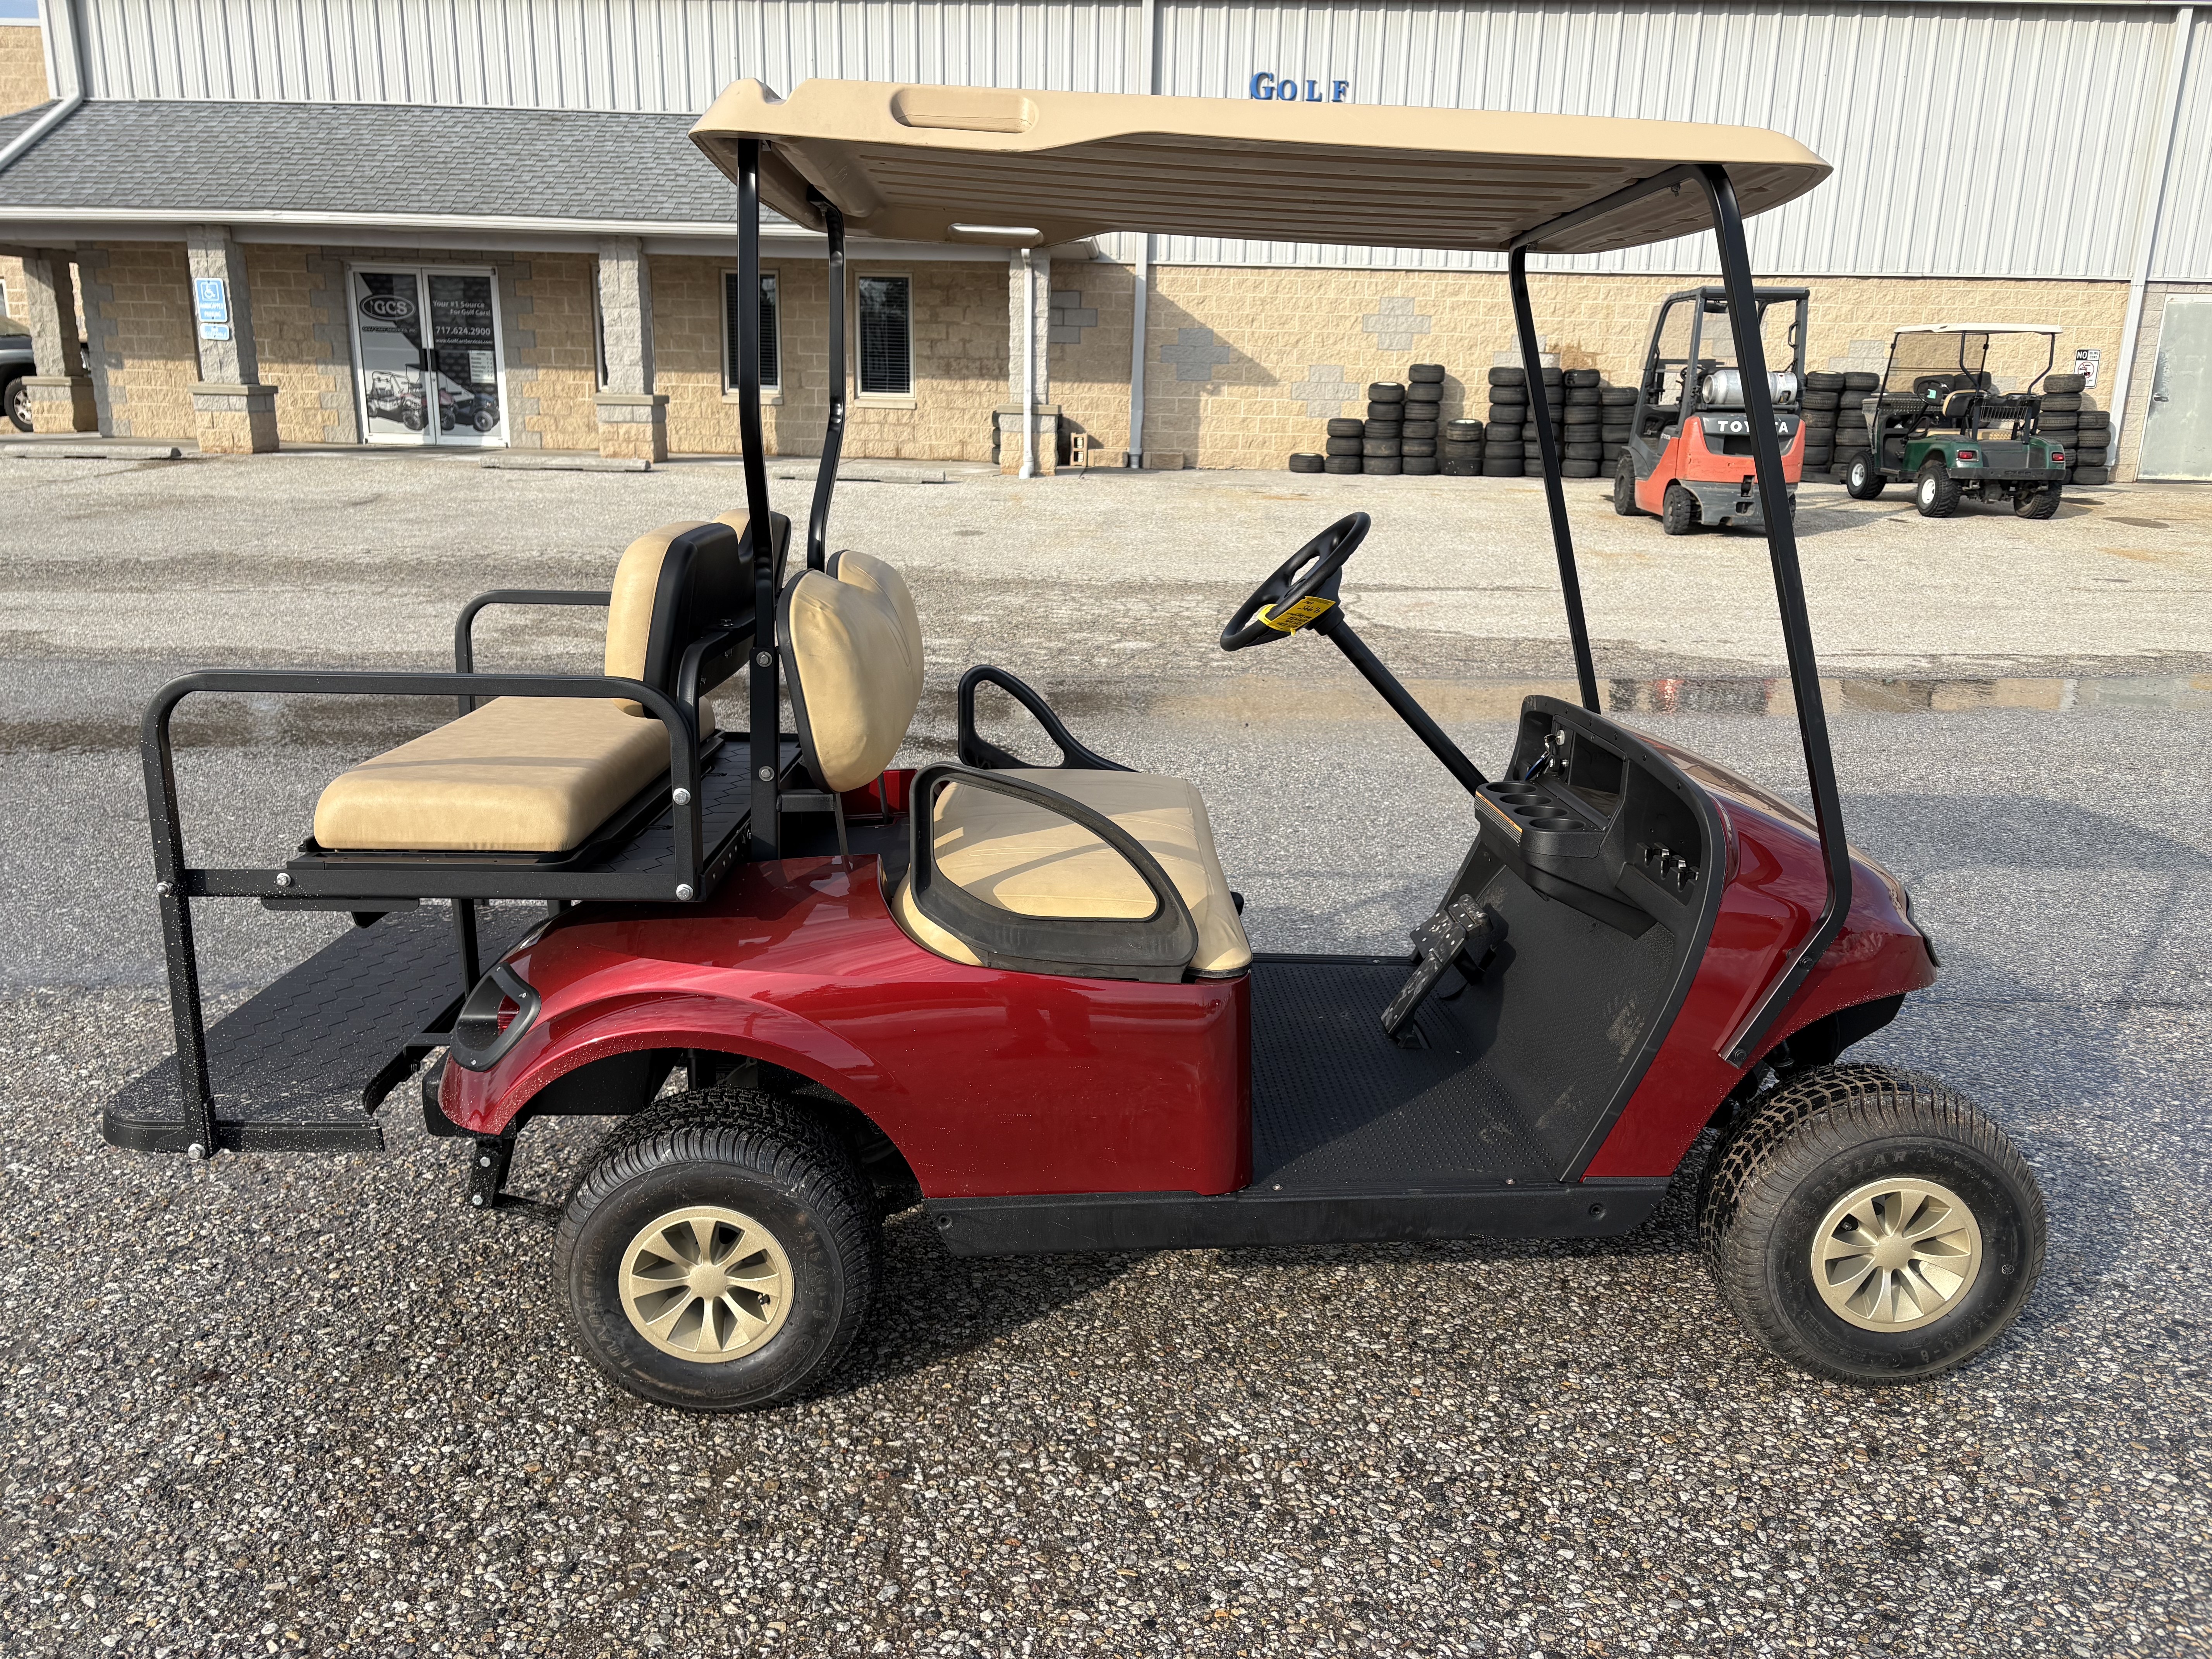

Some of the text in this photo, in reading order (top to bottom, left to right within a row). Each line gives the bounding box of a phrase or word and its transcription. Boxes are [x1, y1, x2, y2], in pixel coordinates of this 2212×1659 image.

[1250, 72, 1349, 102] GOLF
[374, 300, 407, 315] GCS
[435, 326, 491, 336] 717.624.2900
